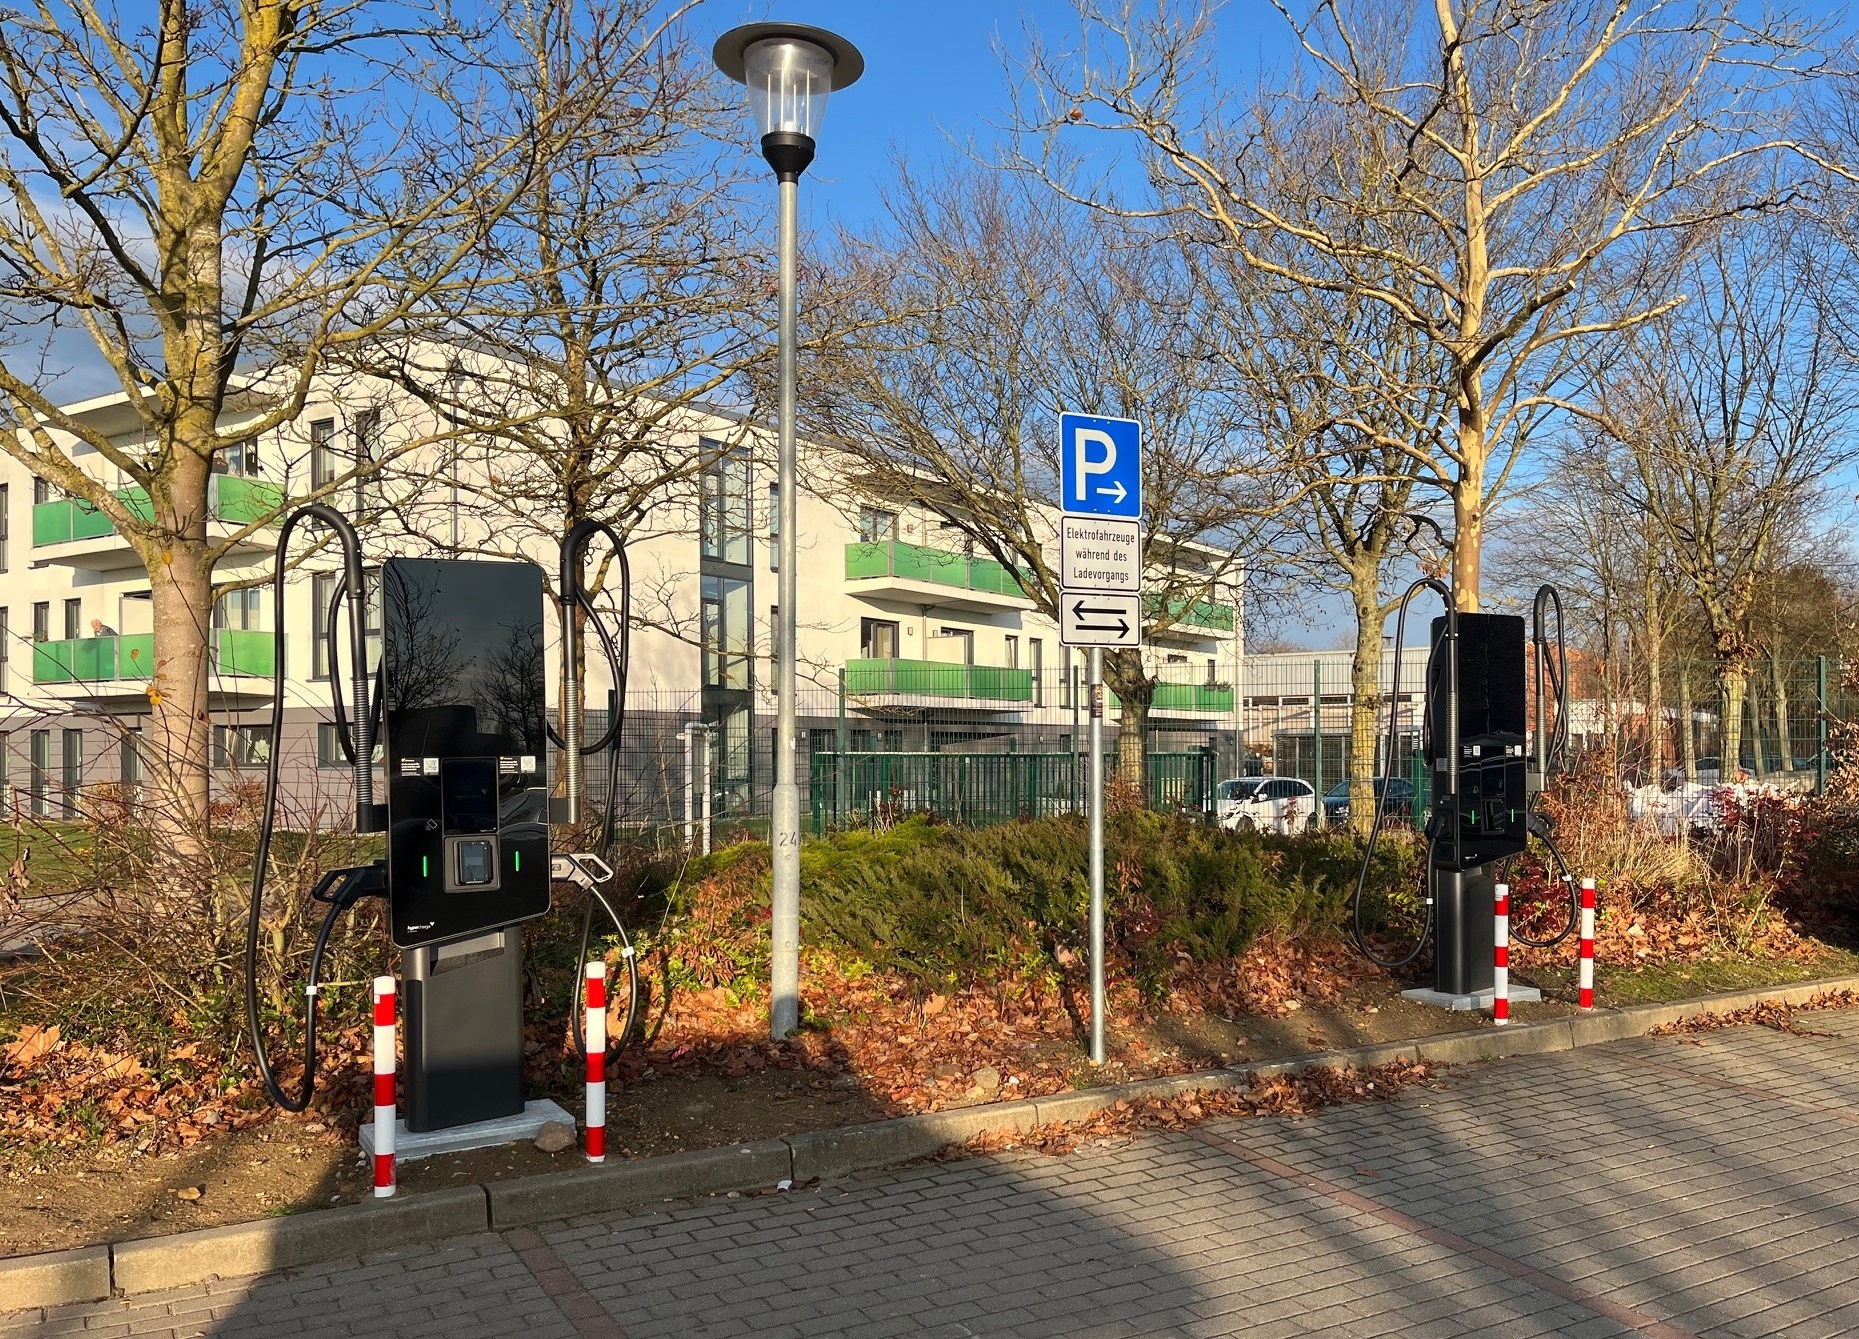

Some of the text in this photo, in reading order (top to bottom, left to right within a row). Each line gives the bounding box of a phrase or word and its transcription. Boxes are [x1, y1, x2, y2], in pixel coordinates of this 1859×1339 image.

[1075, 428, 1117, 501] P
[1067, 527, 1135, 545] Elektrofahrzeuge
[1075, 548, 1128, 562] während des
[1073, 567, 1129, 583] Ladevorgangs
[779, 831, 797, 846] 24
